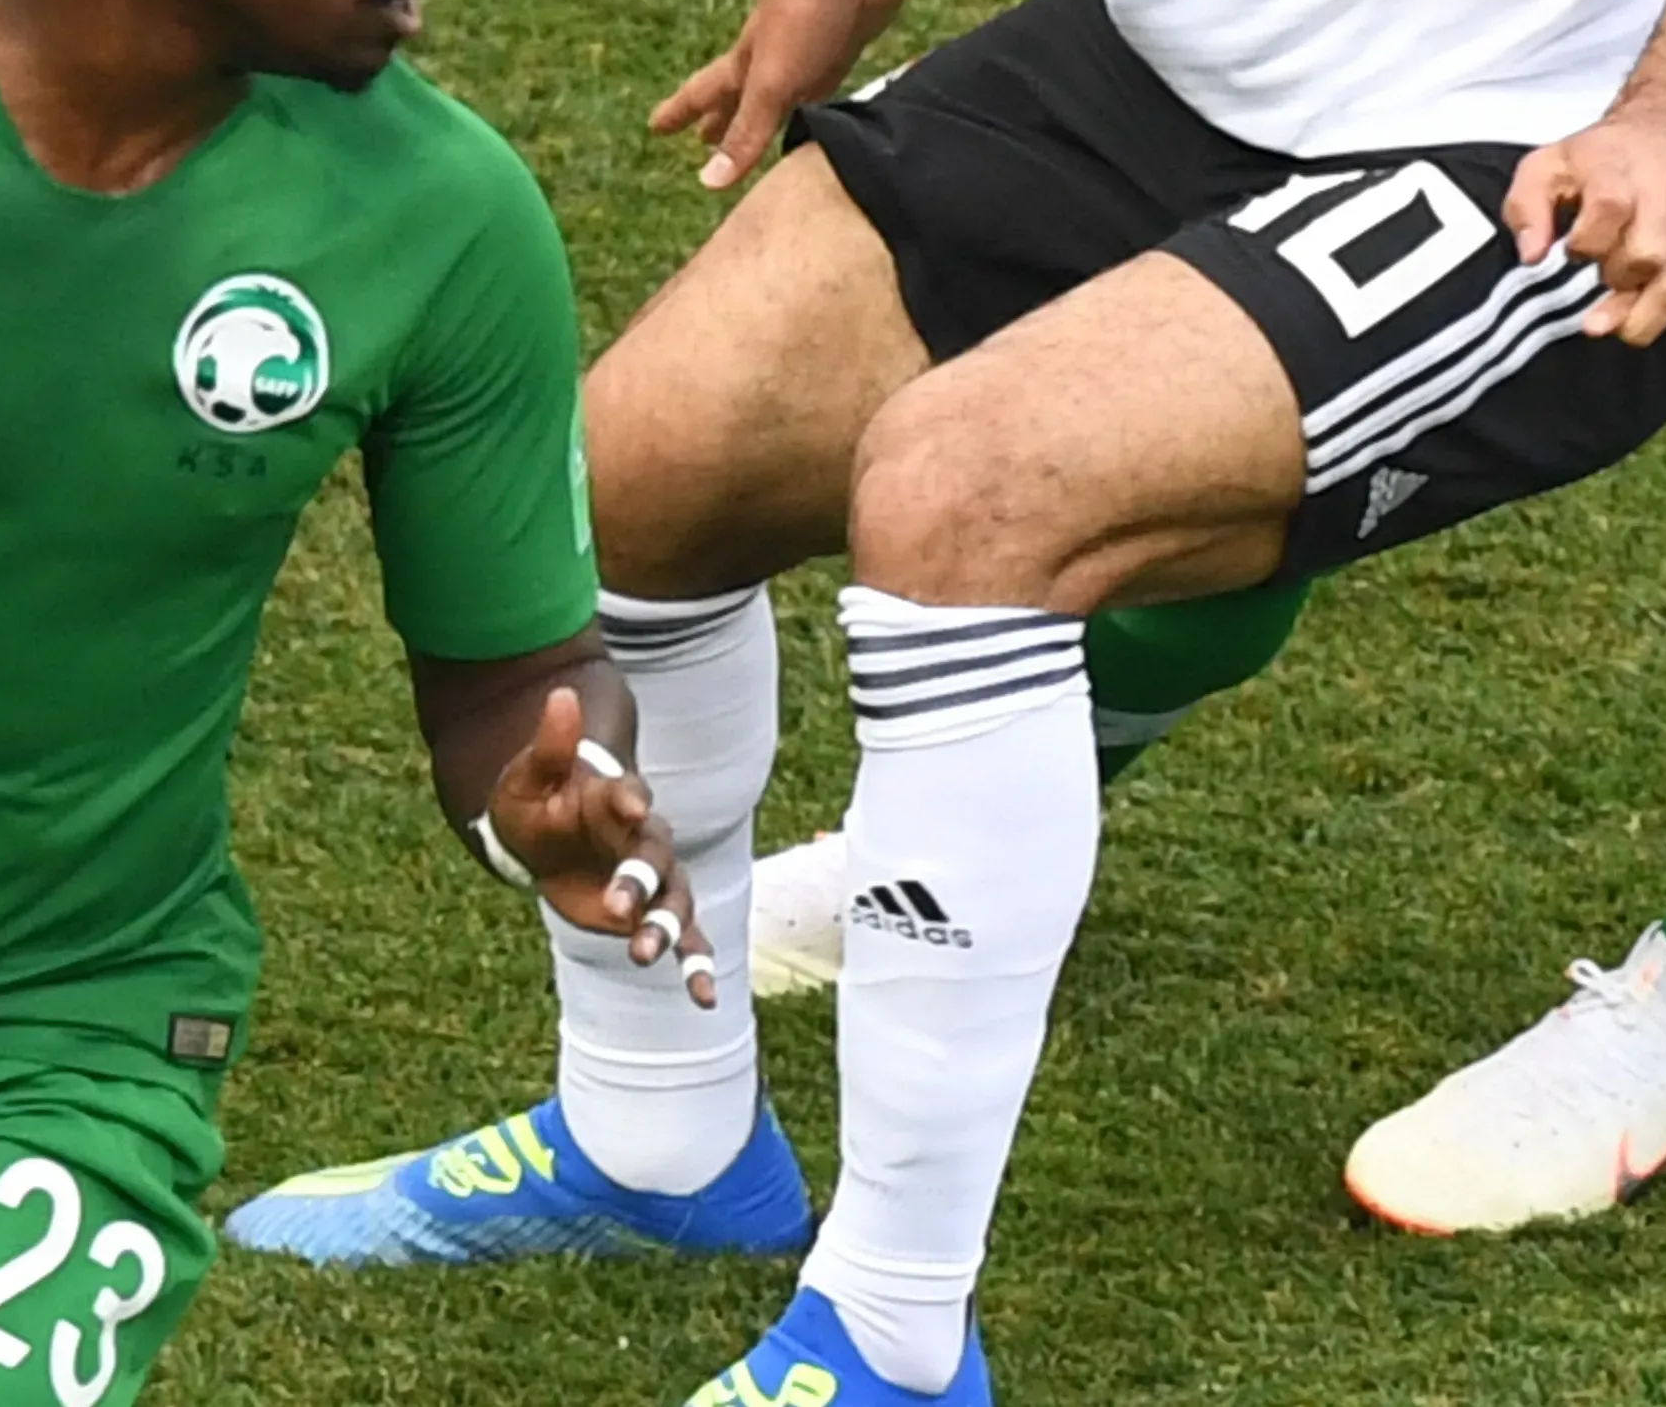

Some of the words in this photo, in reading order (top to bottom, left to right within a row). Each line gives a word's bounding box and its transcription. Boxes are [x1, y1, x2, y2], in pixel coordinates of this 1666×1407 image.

[1226, 160, 1498, 340] 10
[254, 376, 299, 398] SAFF
[176, 446, 267, 478] KSA
